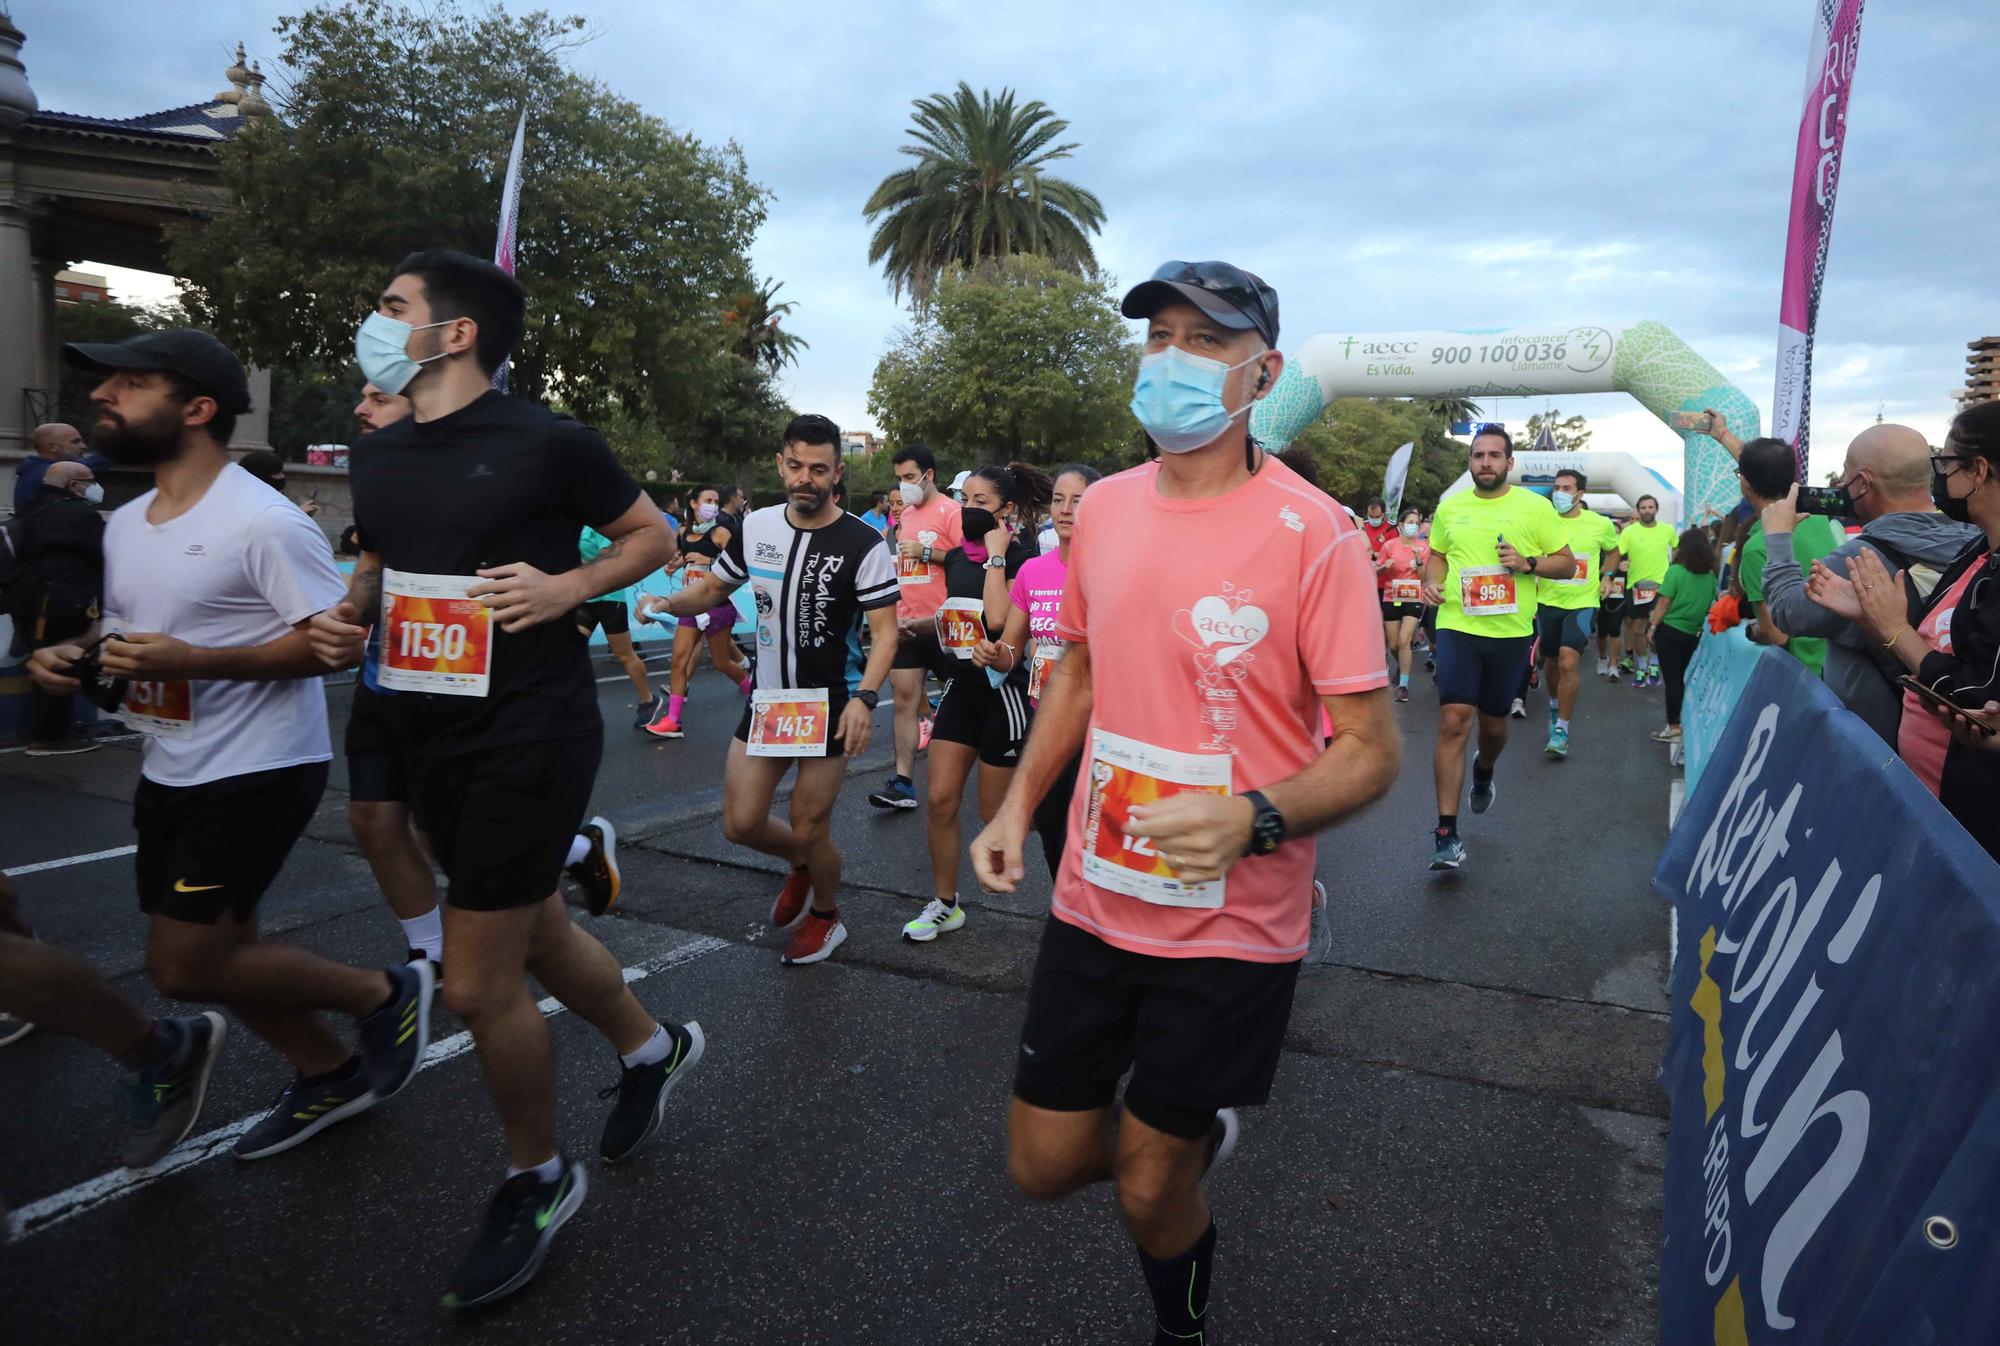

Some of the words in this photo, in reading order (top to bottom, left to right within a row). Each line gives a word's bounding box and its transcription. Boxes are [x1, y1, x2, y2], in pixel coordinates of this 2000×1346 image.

[1362, 342, 1418, 354] aecc
[1431, 346, 1472, 365] 900
[1479, 344, 1519, 363] 100
[1524, 342, 1567, 362] 036
[1366, 363, 1381, 376] Es
[1383, 362, 1416, 376] Vida.
[802, 552, 820, 589] TRAIL
[1480, 584, 1506, 601] 956
[1042, 602, 1053, 612] TE
[799, 592, 812, 648] RUNNERS
[948, 621, 975, 641] 1412
[1200, 615, 1259, 642] aecc
[399, 621, 467, 661] 1130
[775, 715, 815, 737] 1413
